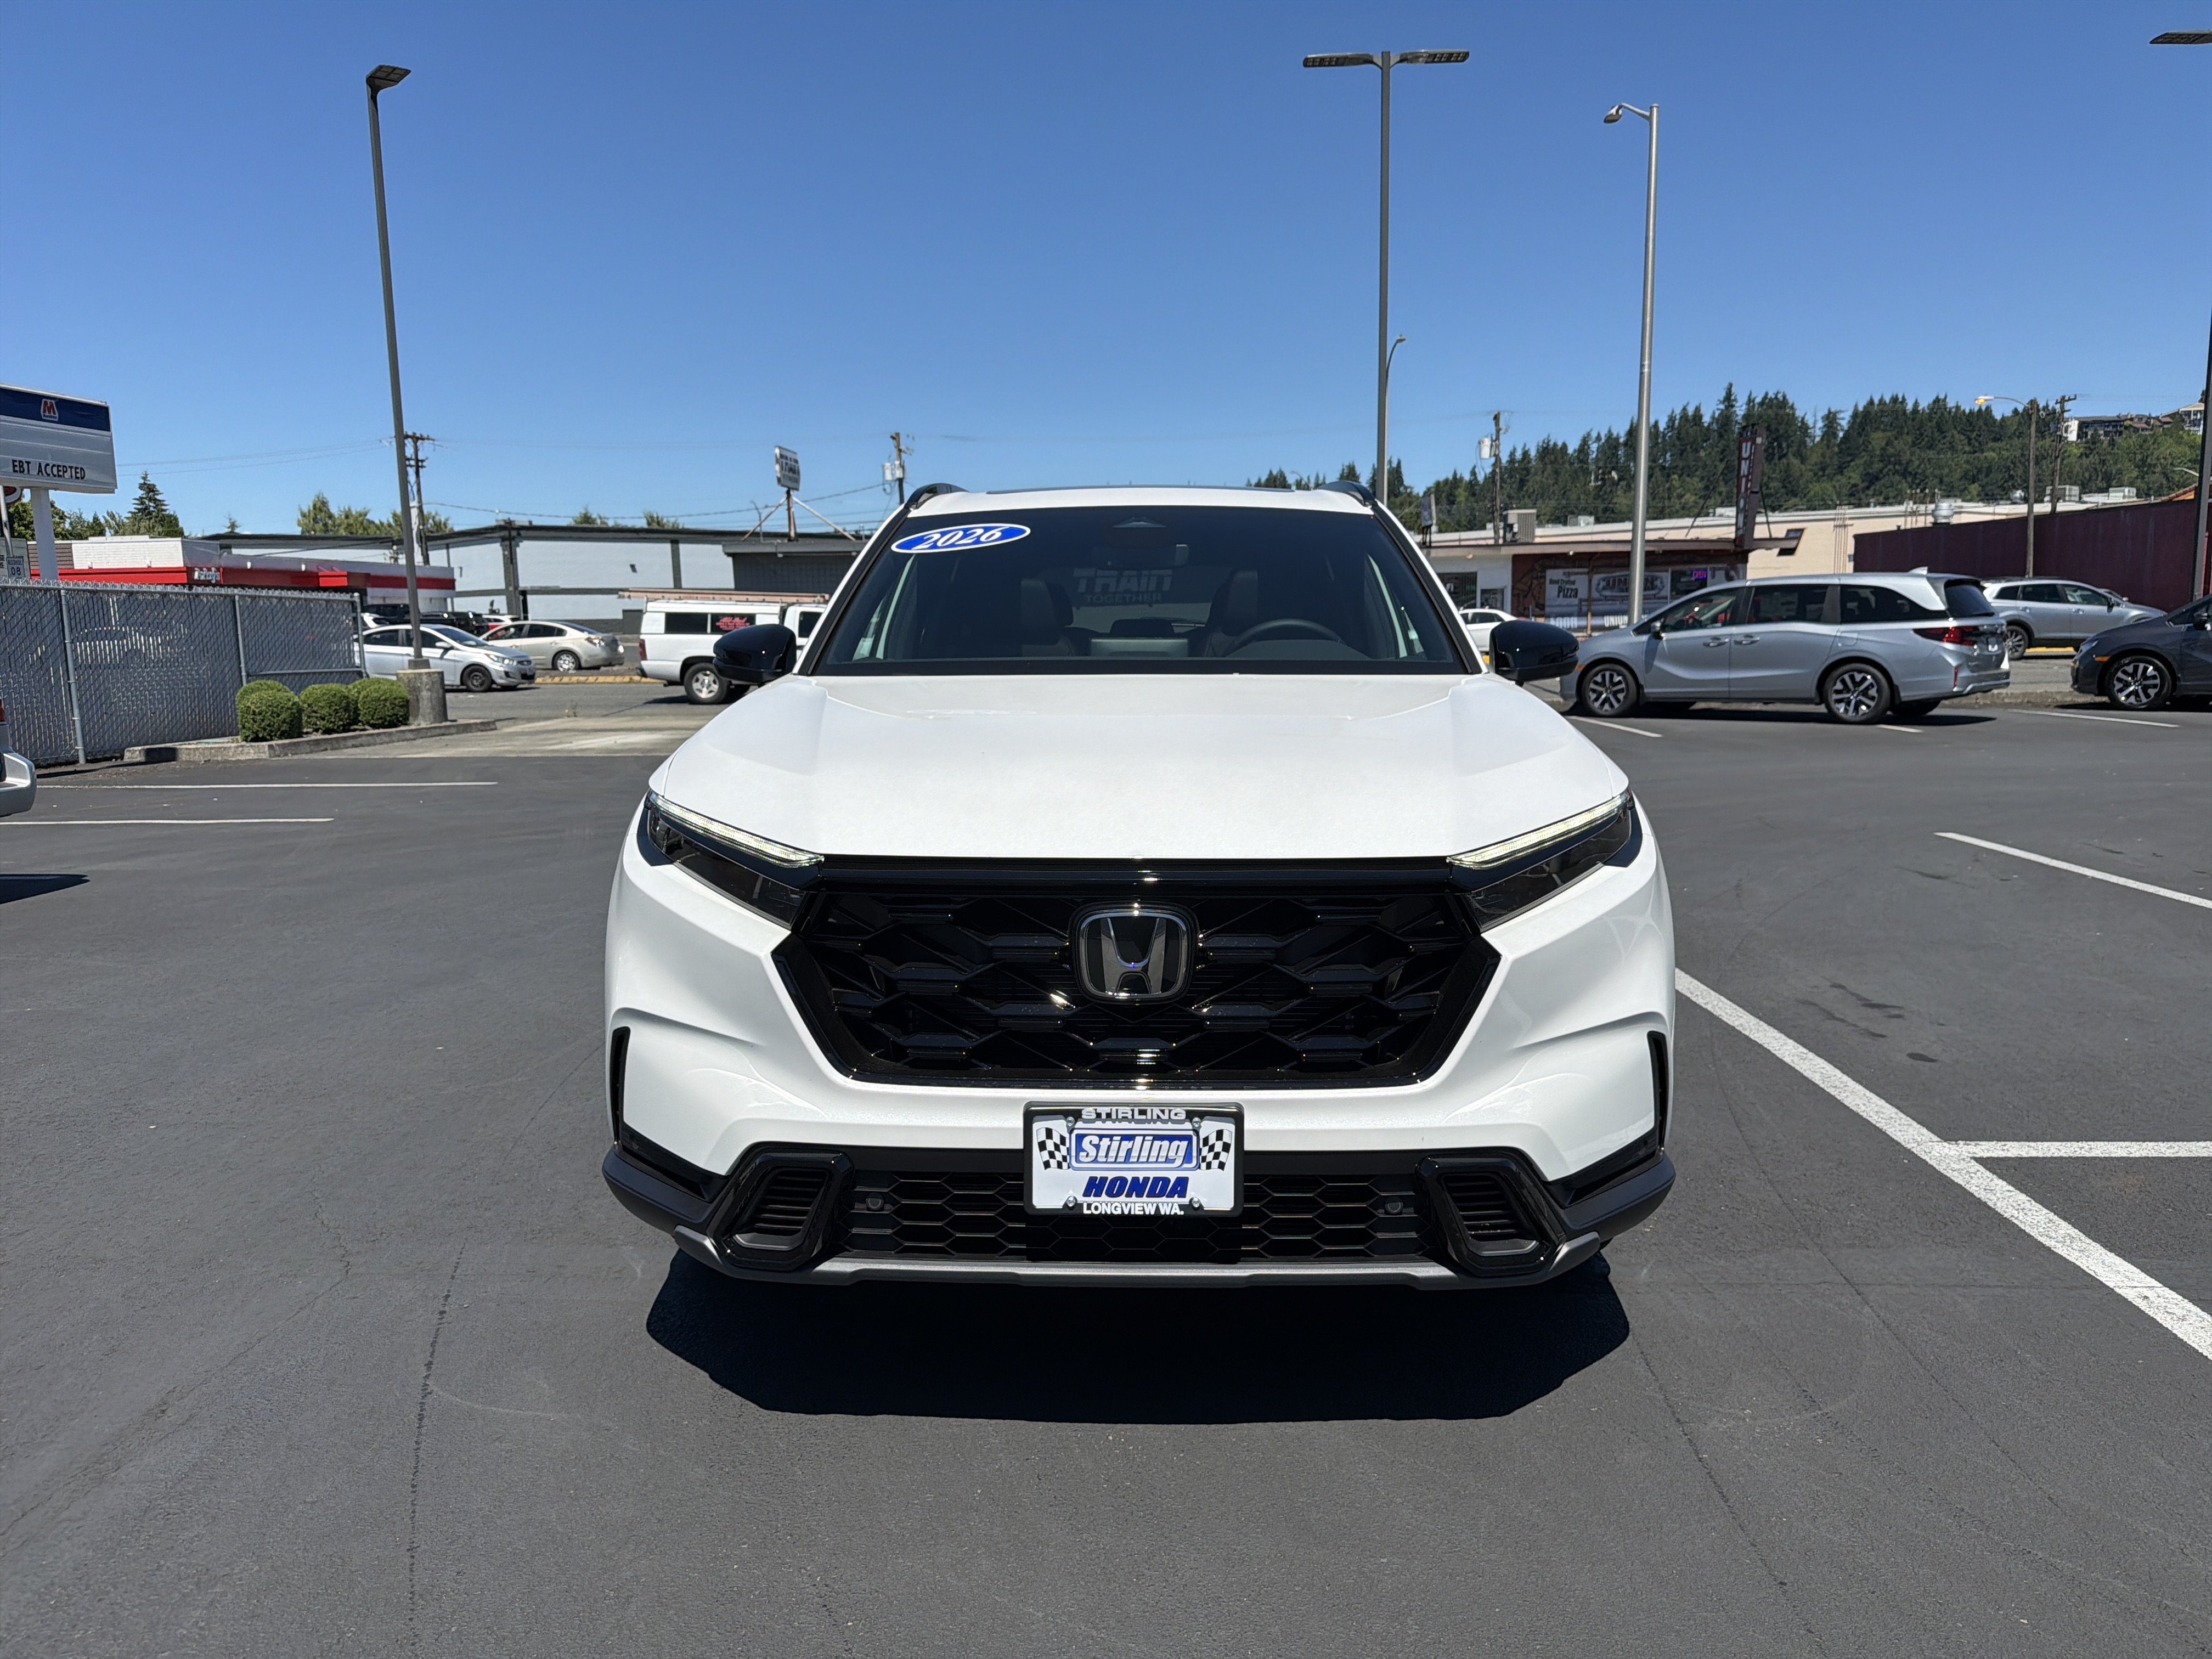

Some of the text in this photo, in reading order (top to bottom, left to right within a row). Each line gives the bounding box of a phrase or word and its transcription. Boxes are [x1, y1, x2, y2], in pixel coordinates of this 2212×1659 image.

[12, 459, 86, 480] EBT ACCEPTED
[911, 526, 1009, 550] 2026
[1085, 592, 1163, 603] TOGETHER
[1557, 585, 1578, 599] Pizza
[1604, 614, 1628, 627] UNION
[1081, 1108, 1187, 1120] STIRLING
[1078, 1135, 1188, 1167] Stirling
[1082, 1176, 1189, 1198] HONDA
[1082, 1203, 1184, 1215] LONGVIEW WA.
